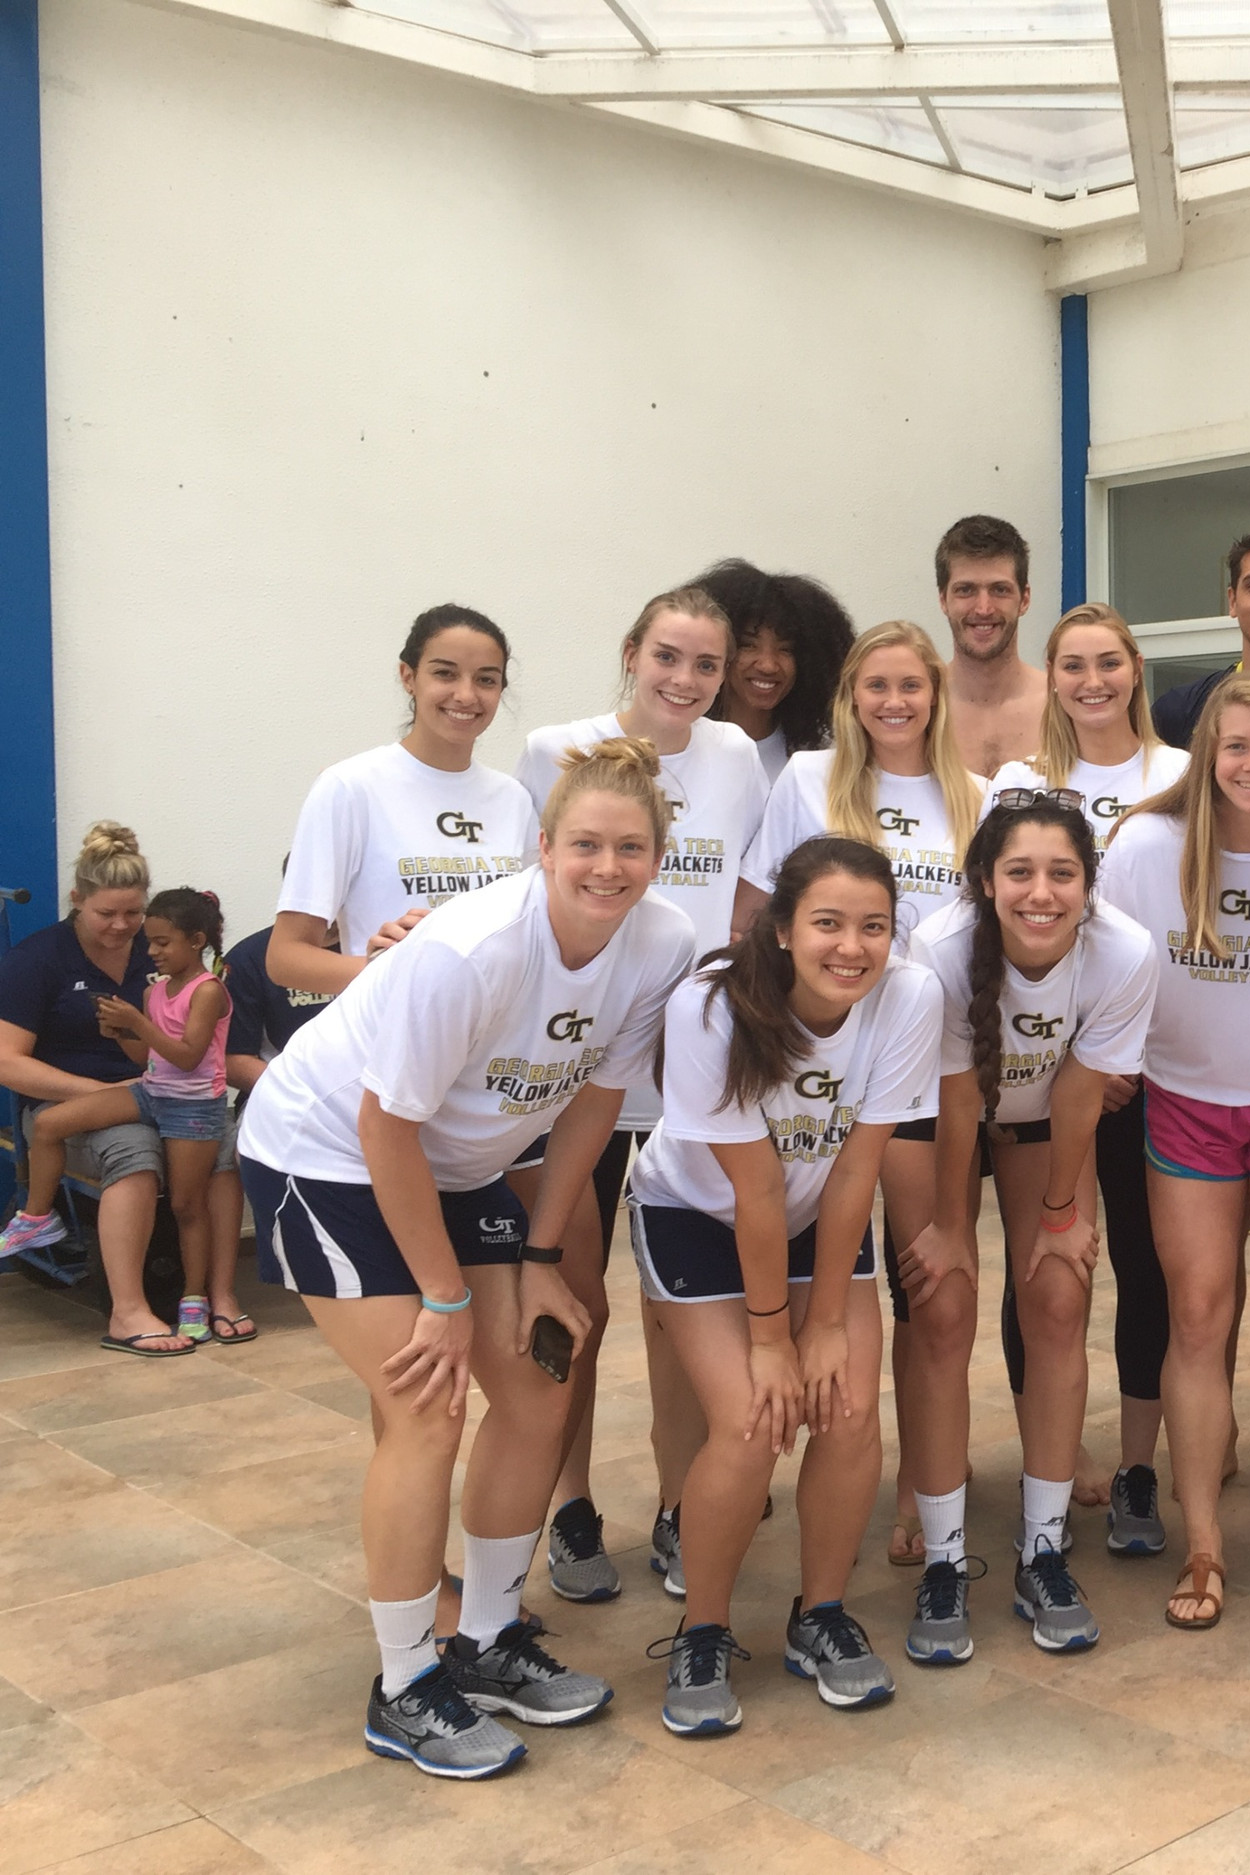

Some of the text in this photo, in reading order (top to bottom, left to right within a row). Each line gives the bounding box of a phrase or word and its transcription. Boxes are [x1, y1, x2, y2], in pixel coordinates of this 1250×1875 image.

[436, 811, 484, 843] GT
[876, 808, 920, 836] GT
[398, 856, 490, 876] GEORGIA
[661, 856, 722, 873] JACKETS
[893, 863, 962, 886] JACKETS
[401, 875, 471, 895] YELLOW
[546, 1009, 594, 1043] GT
[1012, 1012, 1064, 1041] GT
[485, 1075, 555, 1102] YELLOW
[794, 1069, 845, 1104] GT
[478, 1216, 516, 1234] GT
